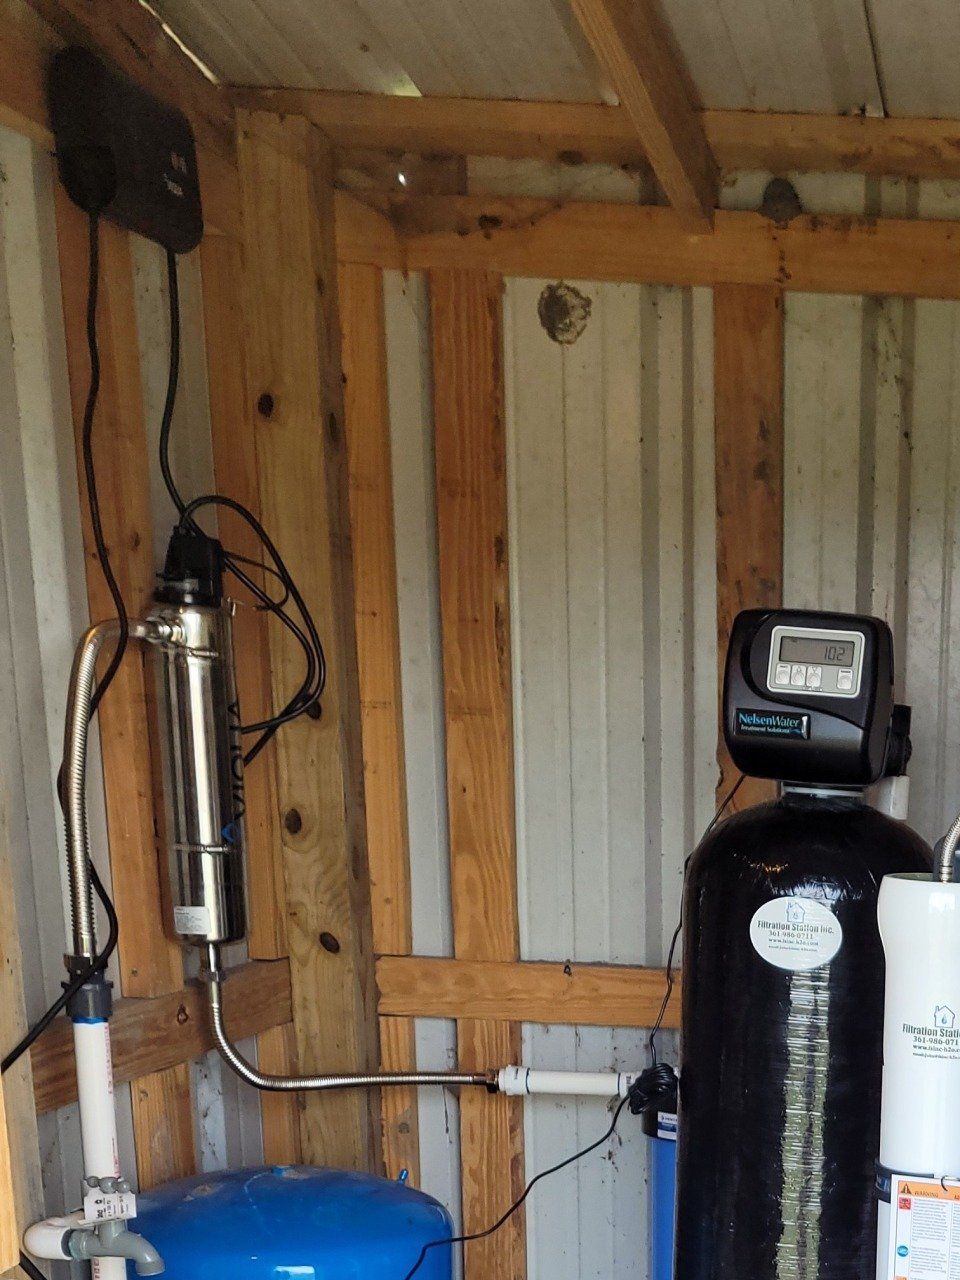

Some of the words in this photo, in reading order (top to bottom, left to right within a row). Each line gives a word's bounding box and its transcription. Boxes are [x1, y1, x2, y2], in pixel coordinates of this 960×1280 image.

[824, 645, 846, 661] 102
[739, 712, 800, 728] NelsenWater
[757, 920, 790, 931] Filtration
[792, 923, 819, 933] Station
[902, 1023, 938, 1037] Filtration
